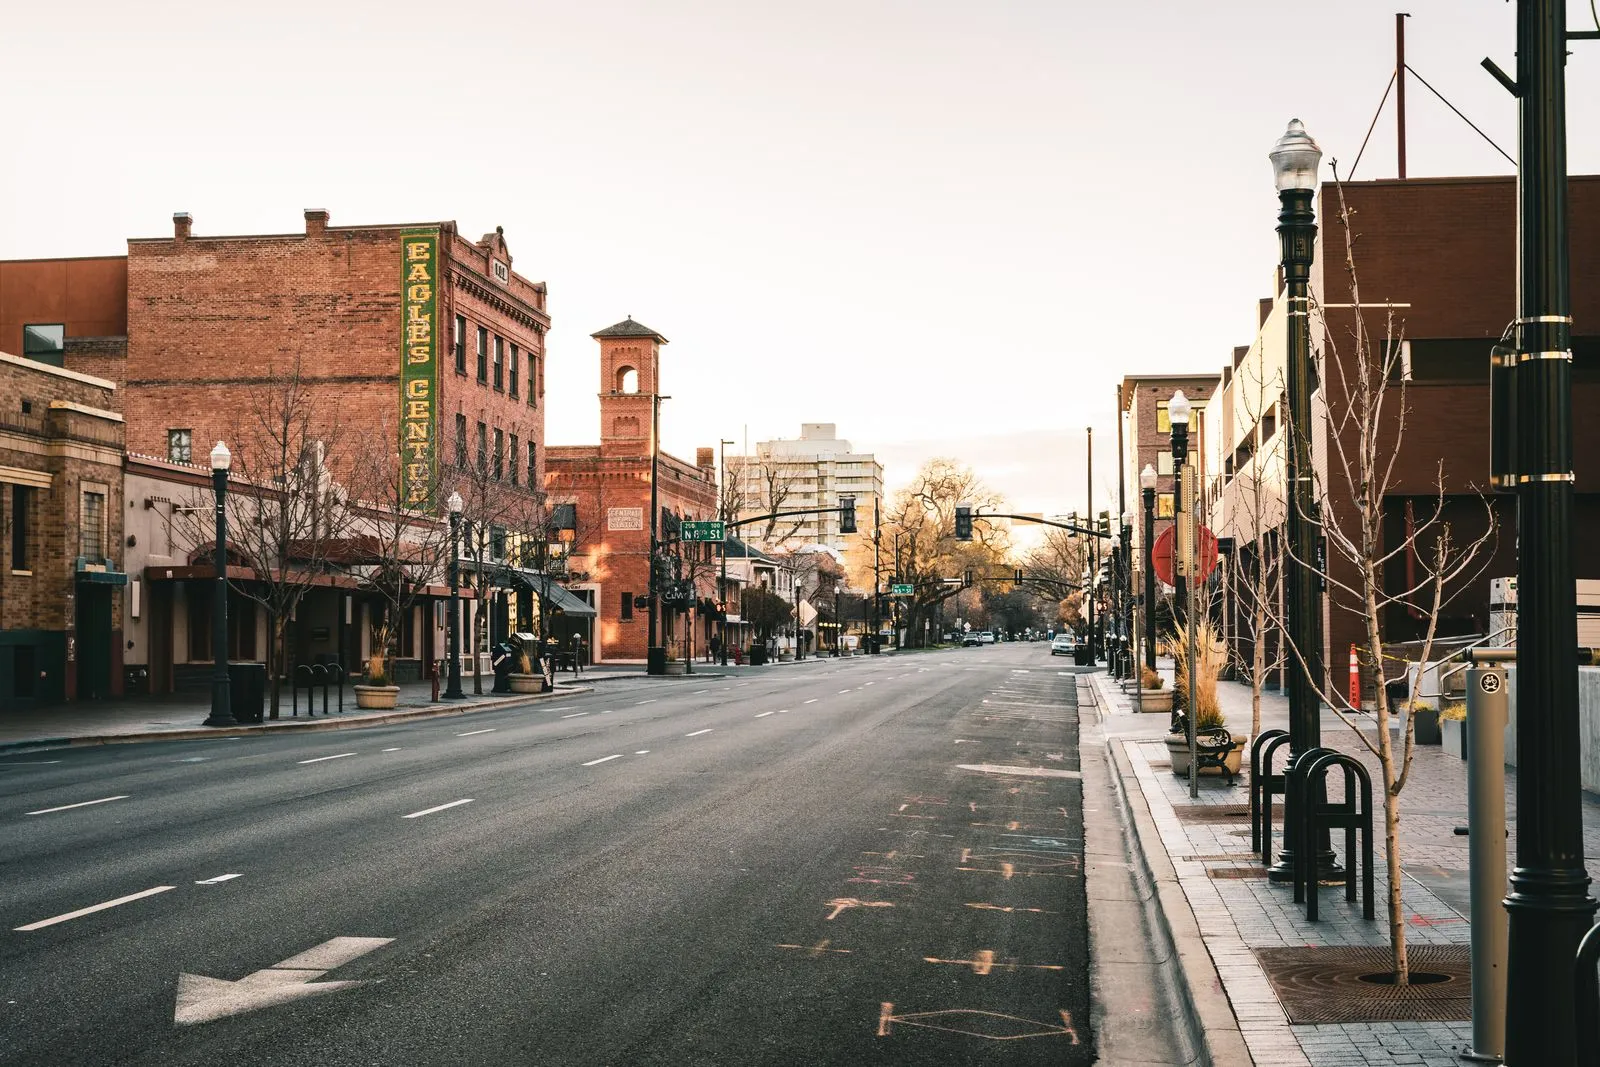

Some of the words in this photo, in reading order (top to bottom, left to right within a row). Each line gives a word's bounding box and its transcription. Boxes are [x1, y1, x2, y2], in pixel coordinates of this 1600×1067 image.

[406, 241, 432, 365] EAGLES
[685, 530, 691, 539] N
[710, 529, 720, 539] St
